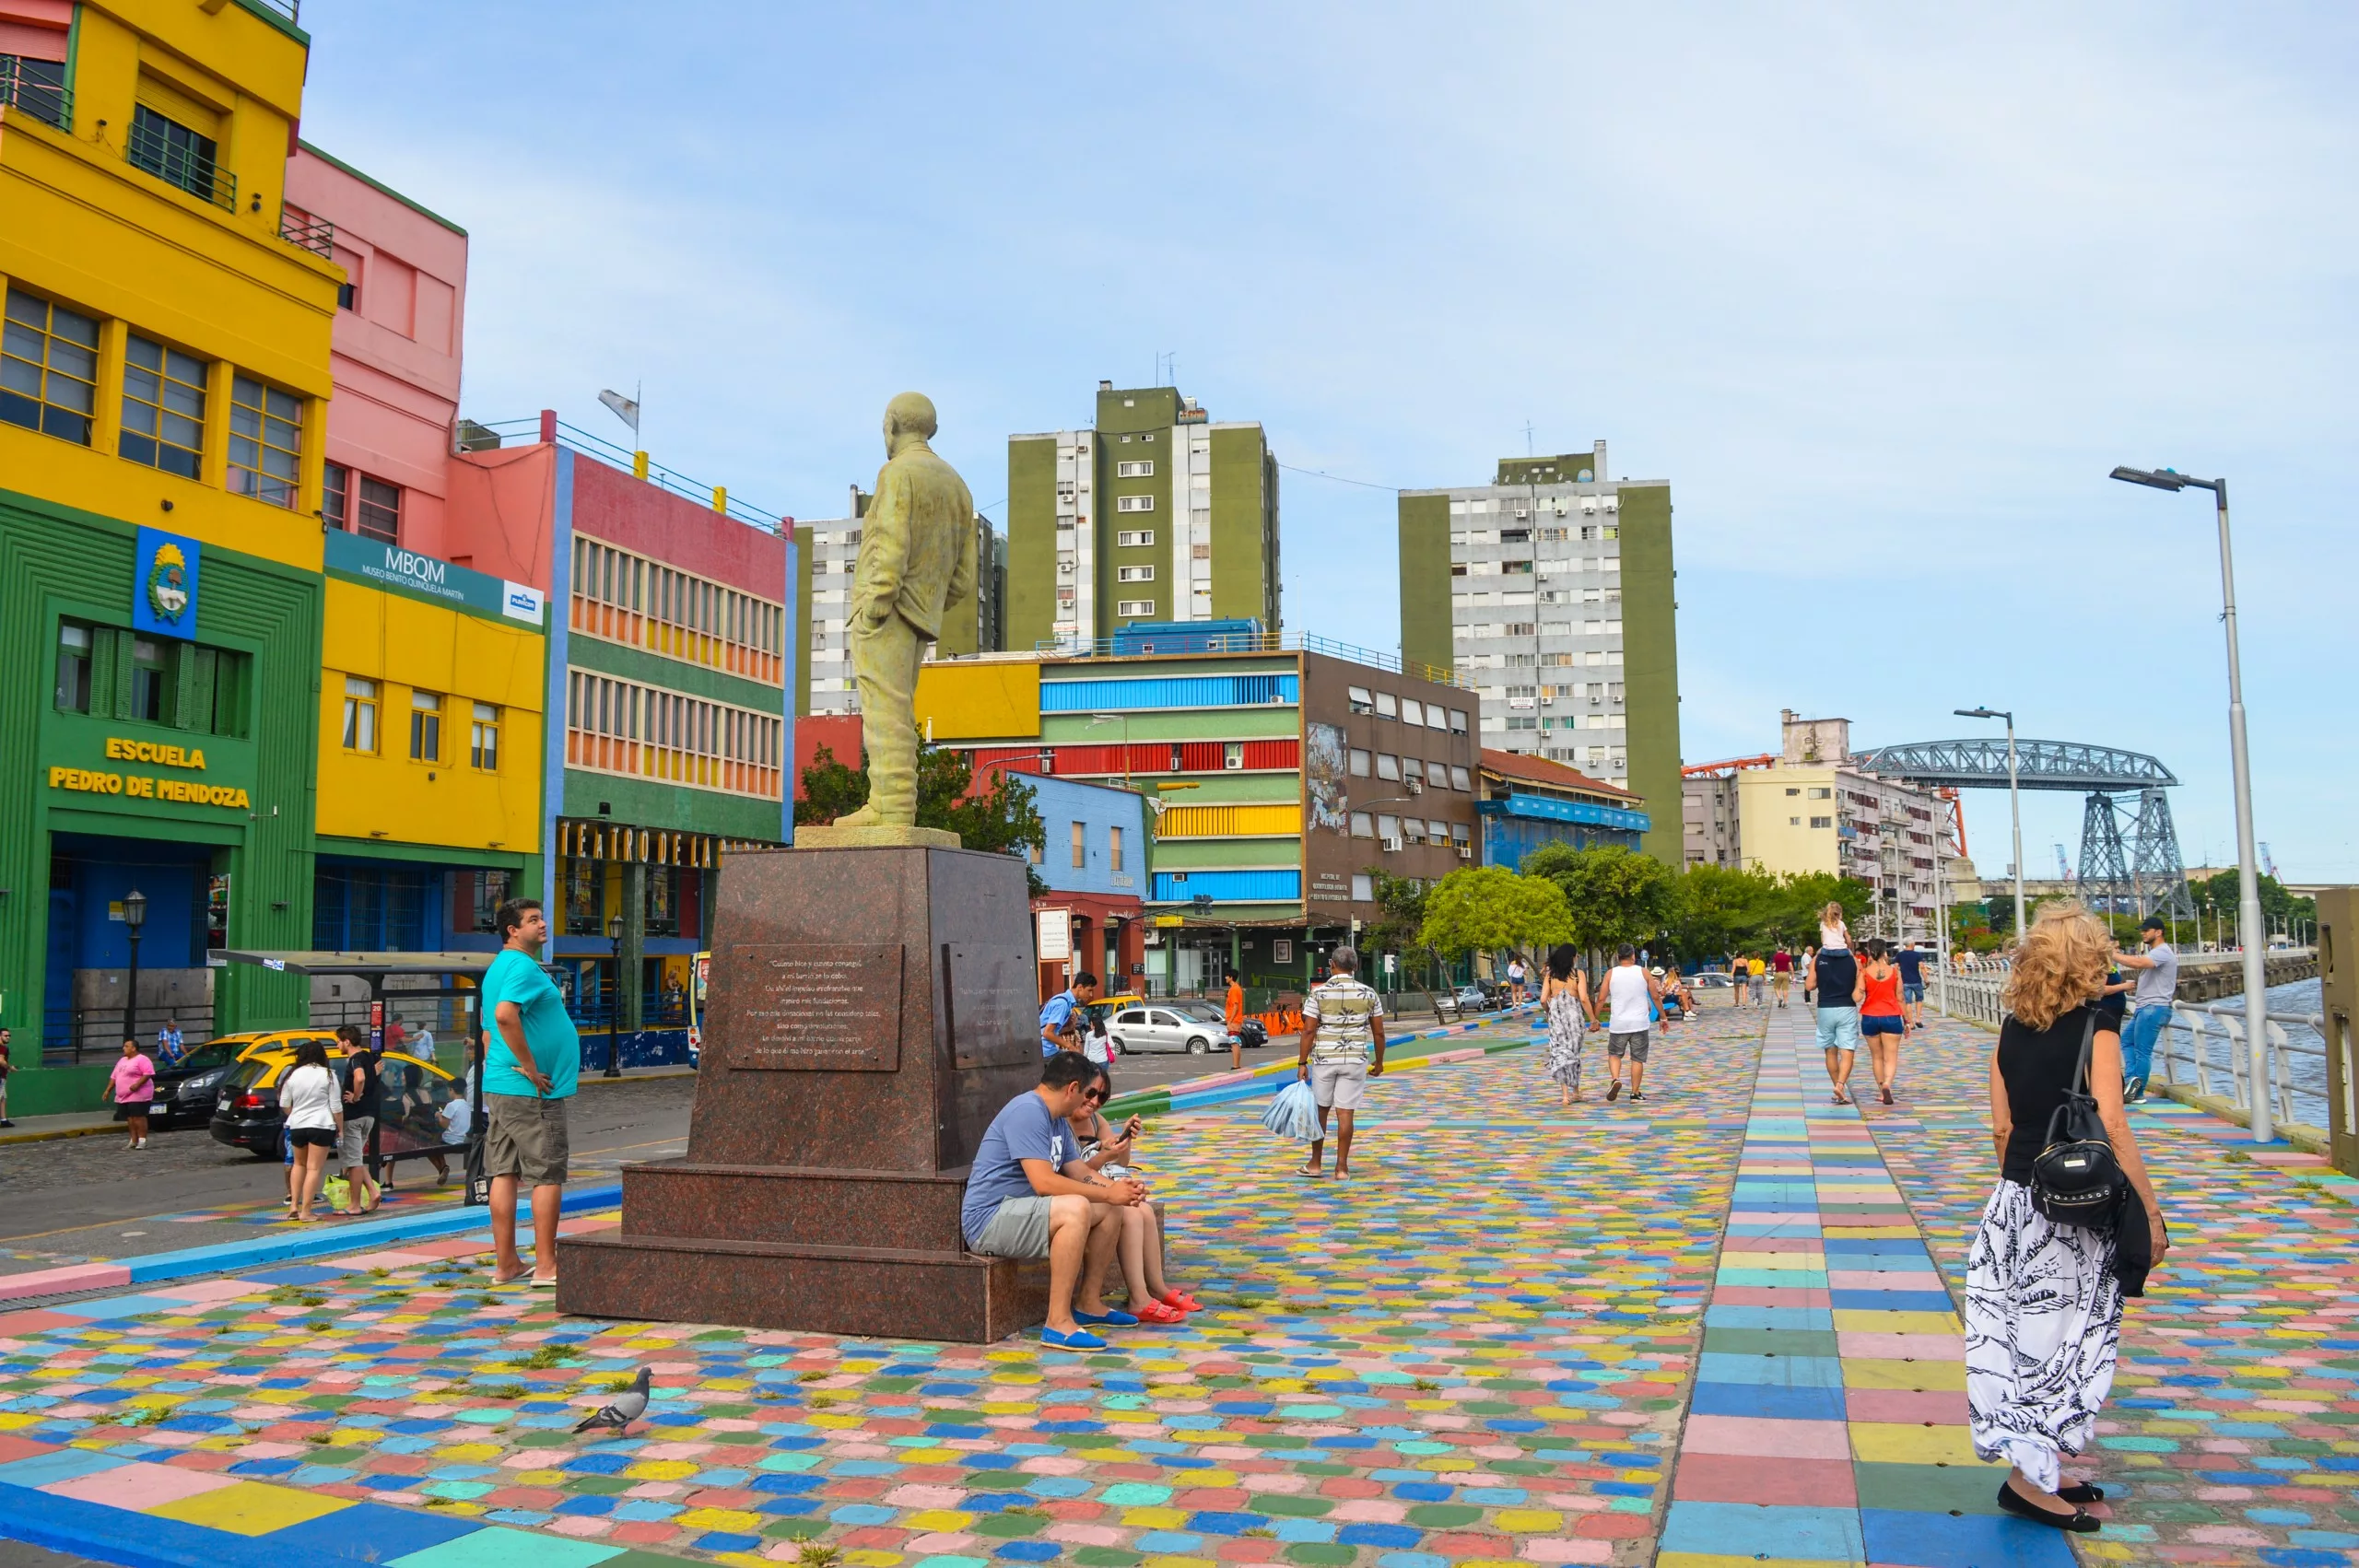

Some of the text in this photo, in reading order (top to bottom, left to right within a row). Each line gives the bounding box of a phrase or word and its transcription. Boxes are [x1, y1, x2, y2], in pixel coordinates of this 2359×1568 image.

[362, 565, 464, 601] MUSEO BENITO QUINQUELA MARTÍN
[385, 547, 445, 585] MBQM
[105, 737, 205, 770] ESCUELA
[49, 766, 250, 808] PEDRO DE MENDOZA
[560, 821, 649, 863] TEATRO
[657, 832, 681, 866] DE
[691, 836, 711, 869] LA
